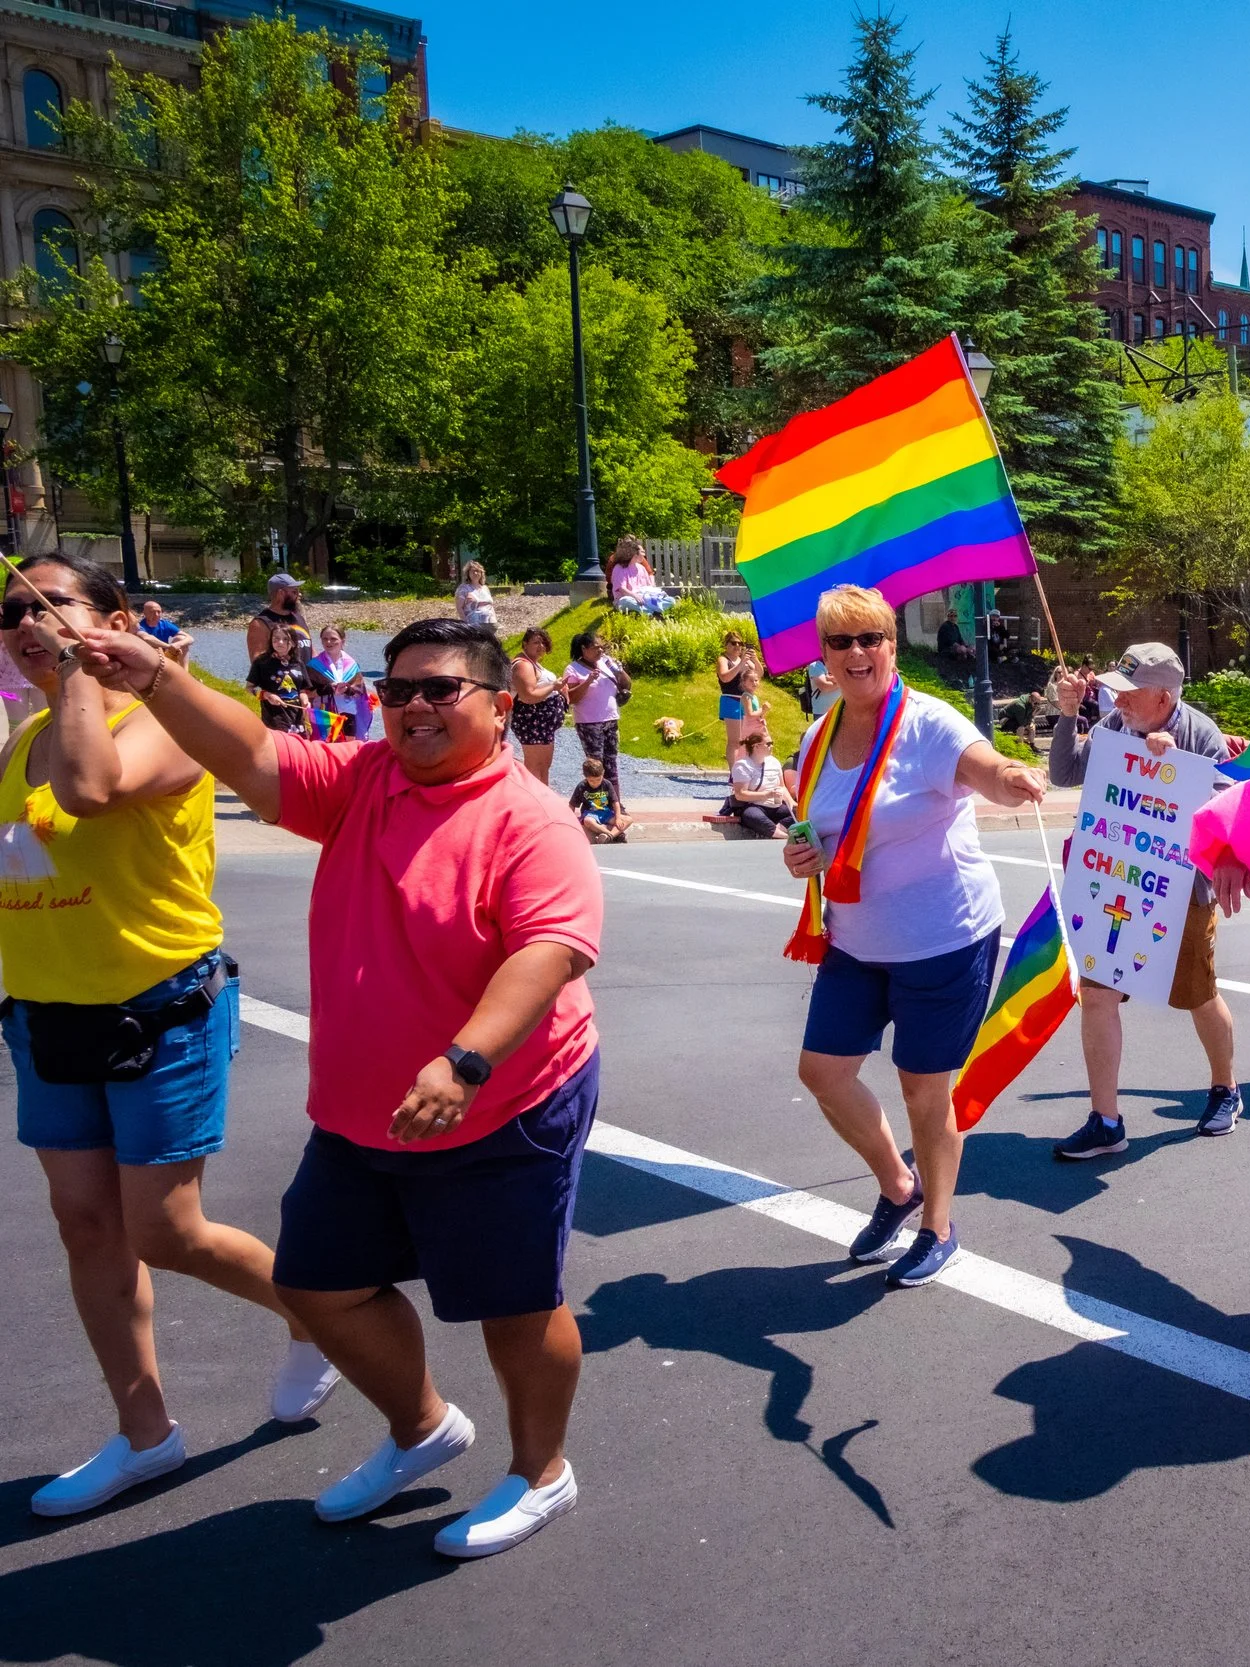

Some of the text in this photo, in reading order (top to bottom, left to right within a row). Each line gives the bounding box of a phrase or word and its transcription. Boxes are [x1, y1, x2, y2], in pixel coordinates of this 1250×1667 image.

[1124, 752, 1177, 785] TWO
[1105, 783, 1179, 823] RIVERS
[1080, 811, 1194, 871] PASTORAL
[1083, 848, 1170, 898] CHARGE
[49, 886, 92, 909] soul
